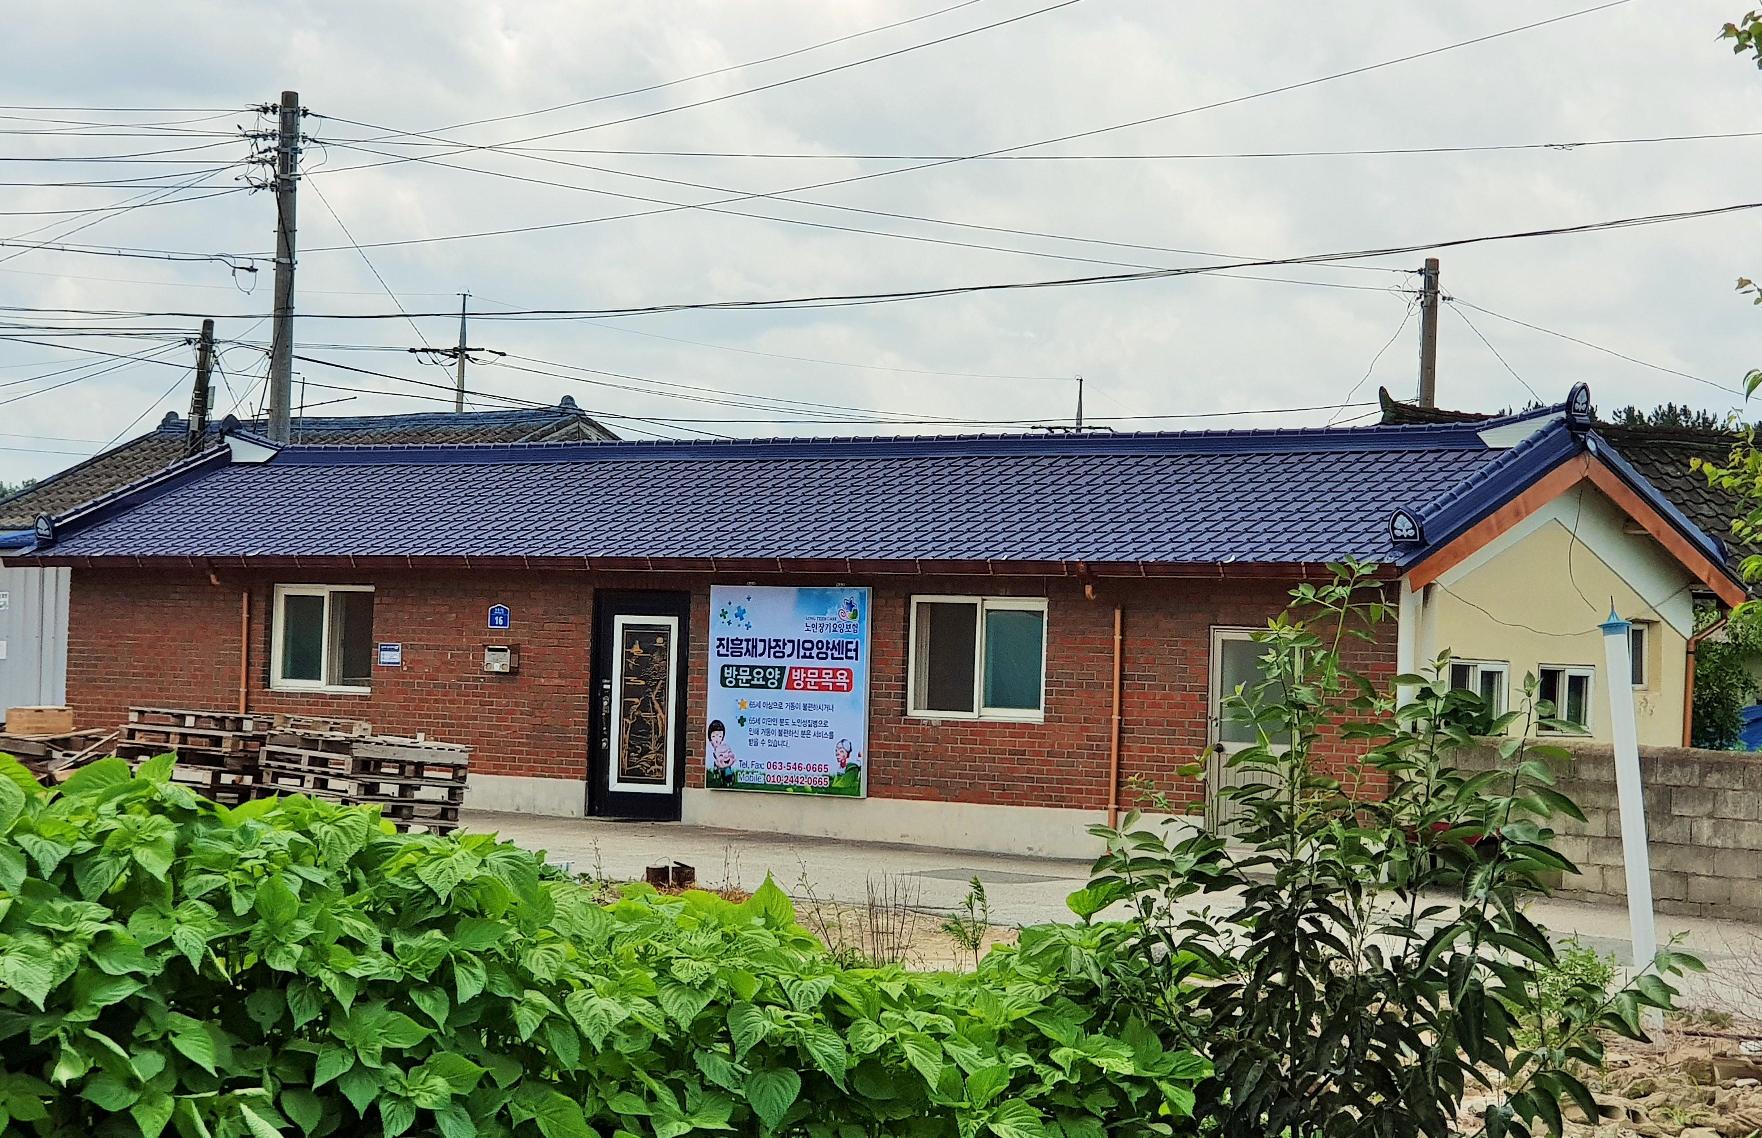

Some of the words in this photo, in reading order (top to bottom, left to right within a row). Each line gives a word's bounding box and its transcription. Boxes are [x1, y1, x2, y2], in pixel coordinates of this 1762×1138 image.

[494, 616, 504, 626] 16
[804, 622, 859, 634] 노인장기요양보험
[715, 636, 859, 661] 진흥재가장기요양센터
[724, 666, 781, 687] 방문요양
[792, 668, 849, 691] 방문목욕
[762, 701, 784, 710] 이상으로
[785, 702, 801, 711] 거동이
[802, 703, 834, 712] 불편하시거나
[779, 718, 790, 727] 분도
[761, 728, 777, 737] 거동이
[778, 729, 800, 738] 불편하신
[812, 730, 834, 740] 서비스를
[760, 739, 766, 747] 수
[766, 761, 829, 773] 063-546-0665
[766, 774, 829, 786] 010-2442-0665
